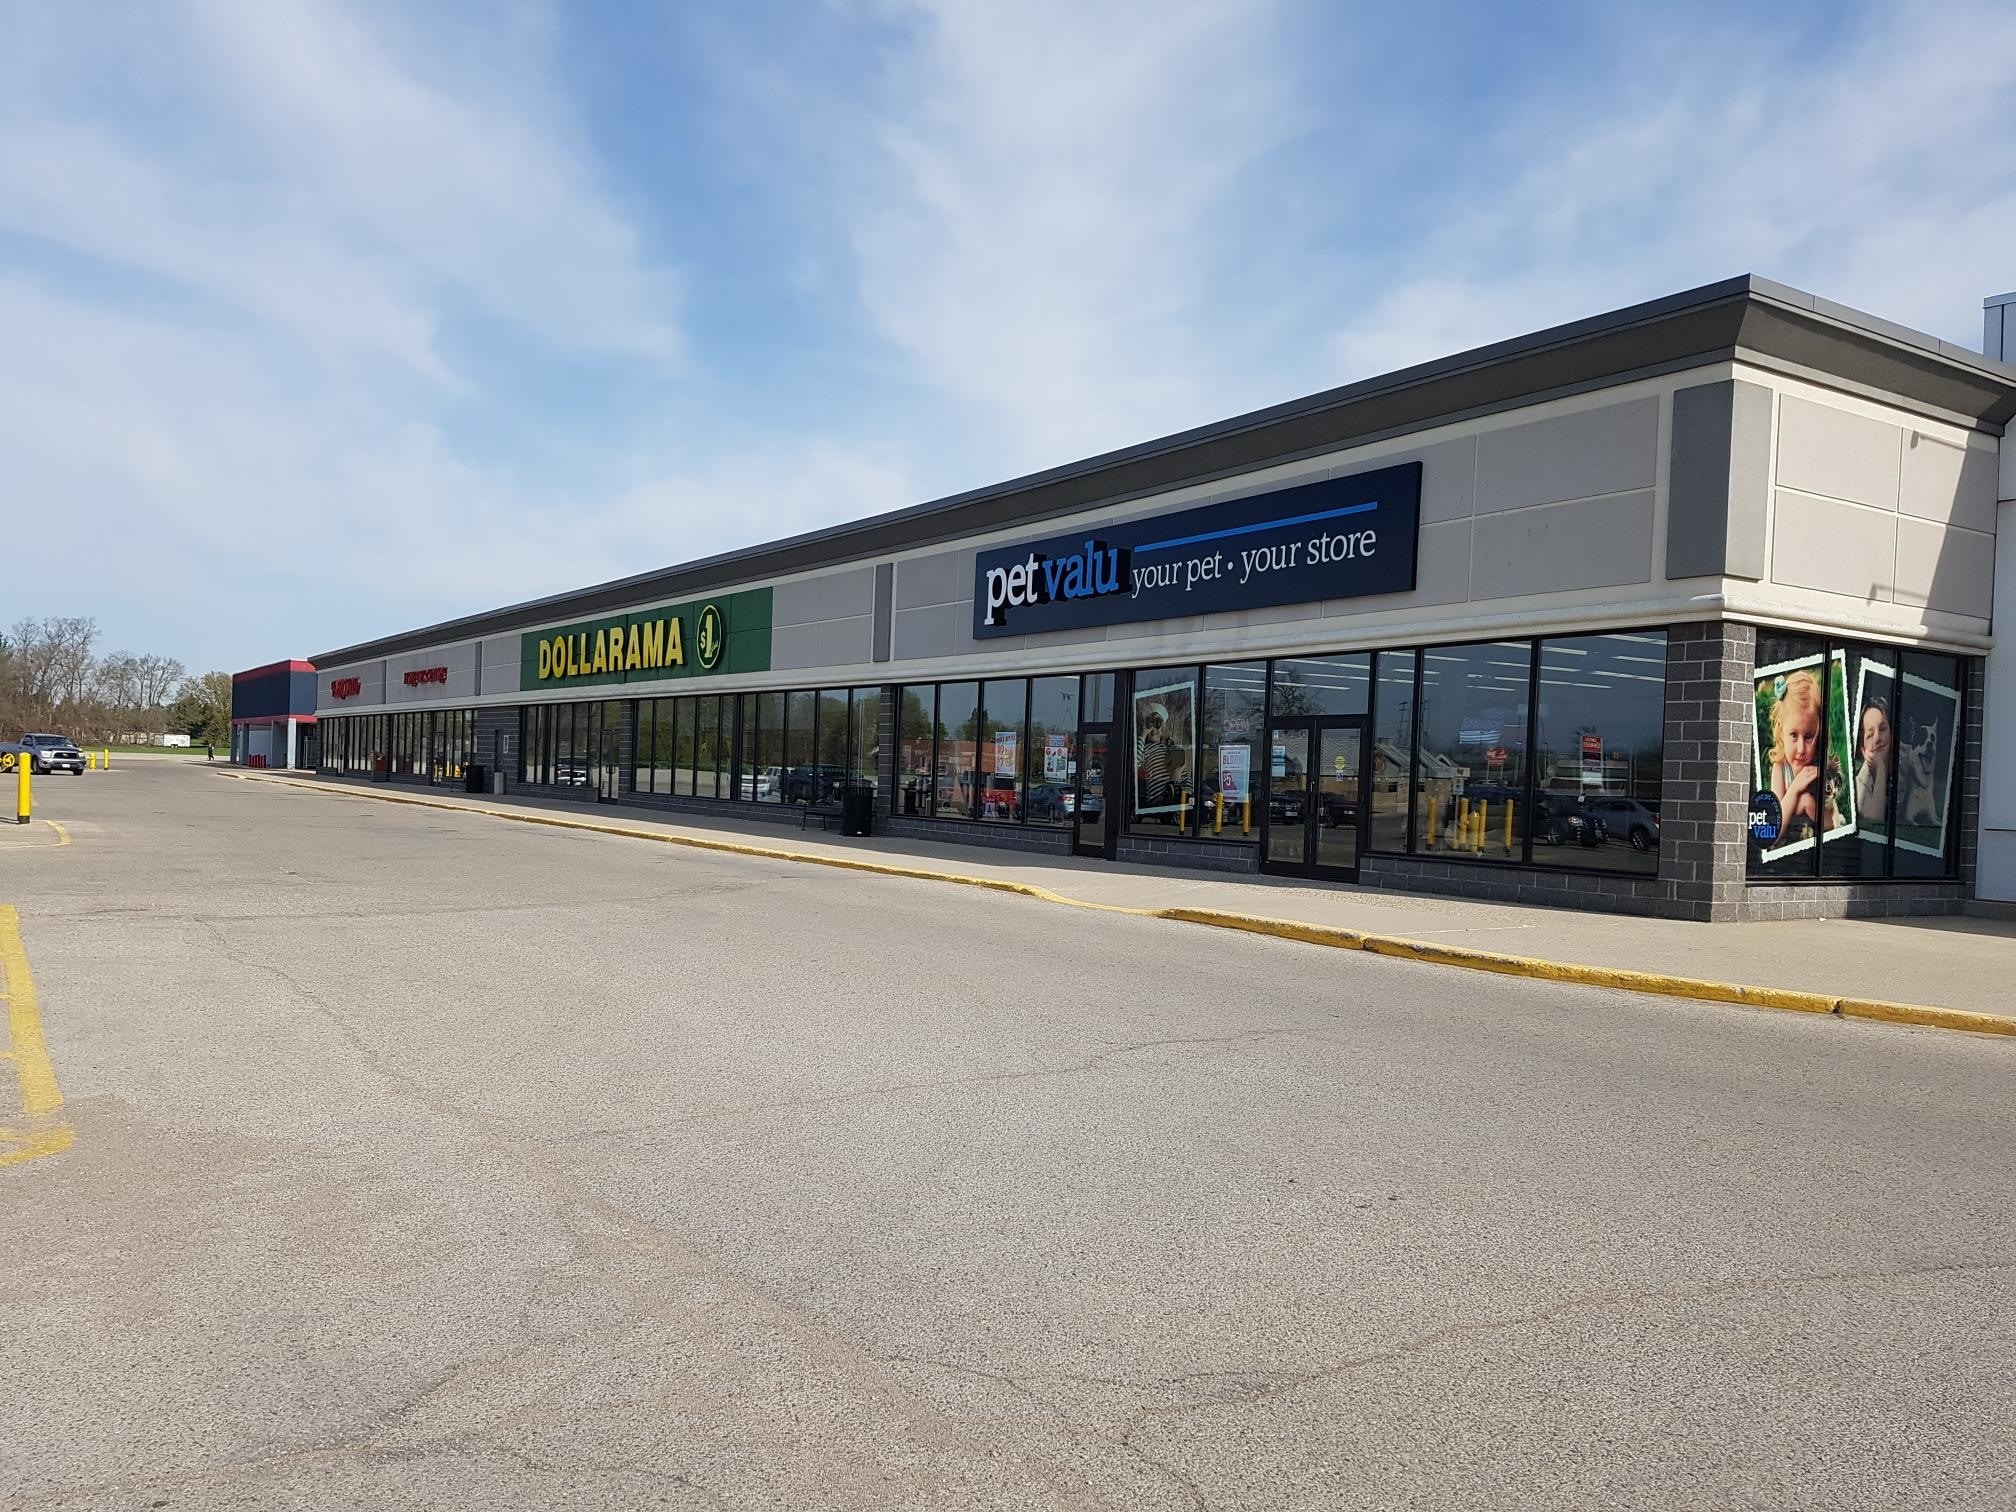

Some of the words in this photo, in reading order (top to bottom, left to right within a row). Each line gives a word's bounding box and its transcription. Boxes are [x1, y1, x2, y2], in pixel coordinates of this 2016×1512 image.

[984, 553, 1039, 625] pet
[1042, 540, 1118, 601] valu
[1131, 559, 1183, 599] your
[1185, 550, 1223, 591] pet
[1239, 540, 1302, 584] your
[1306, 529, 1377, 564] store
[538, 617, 684, 680] DOLLARAMA
[1748, 809, 1768, 830] pet
[1754, 824, 1777, 839] valu
